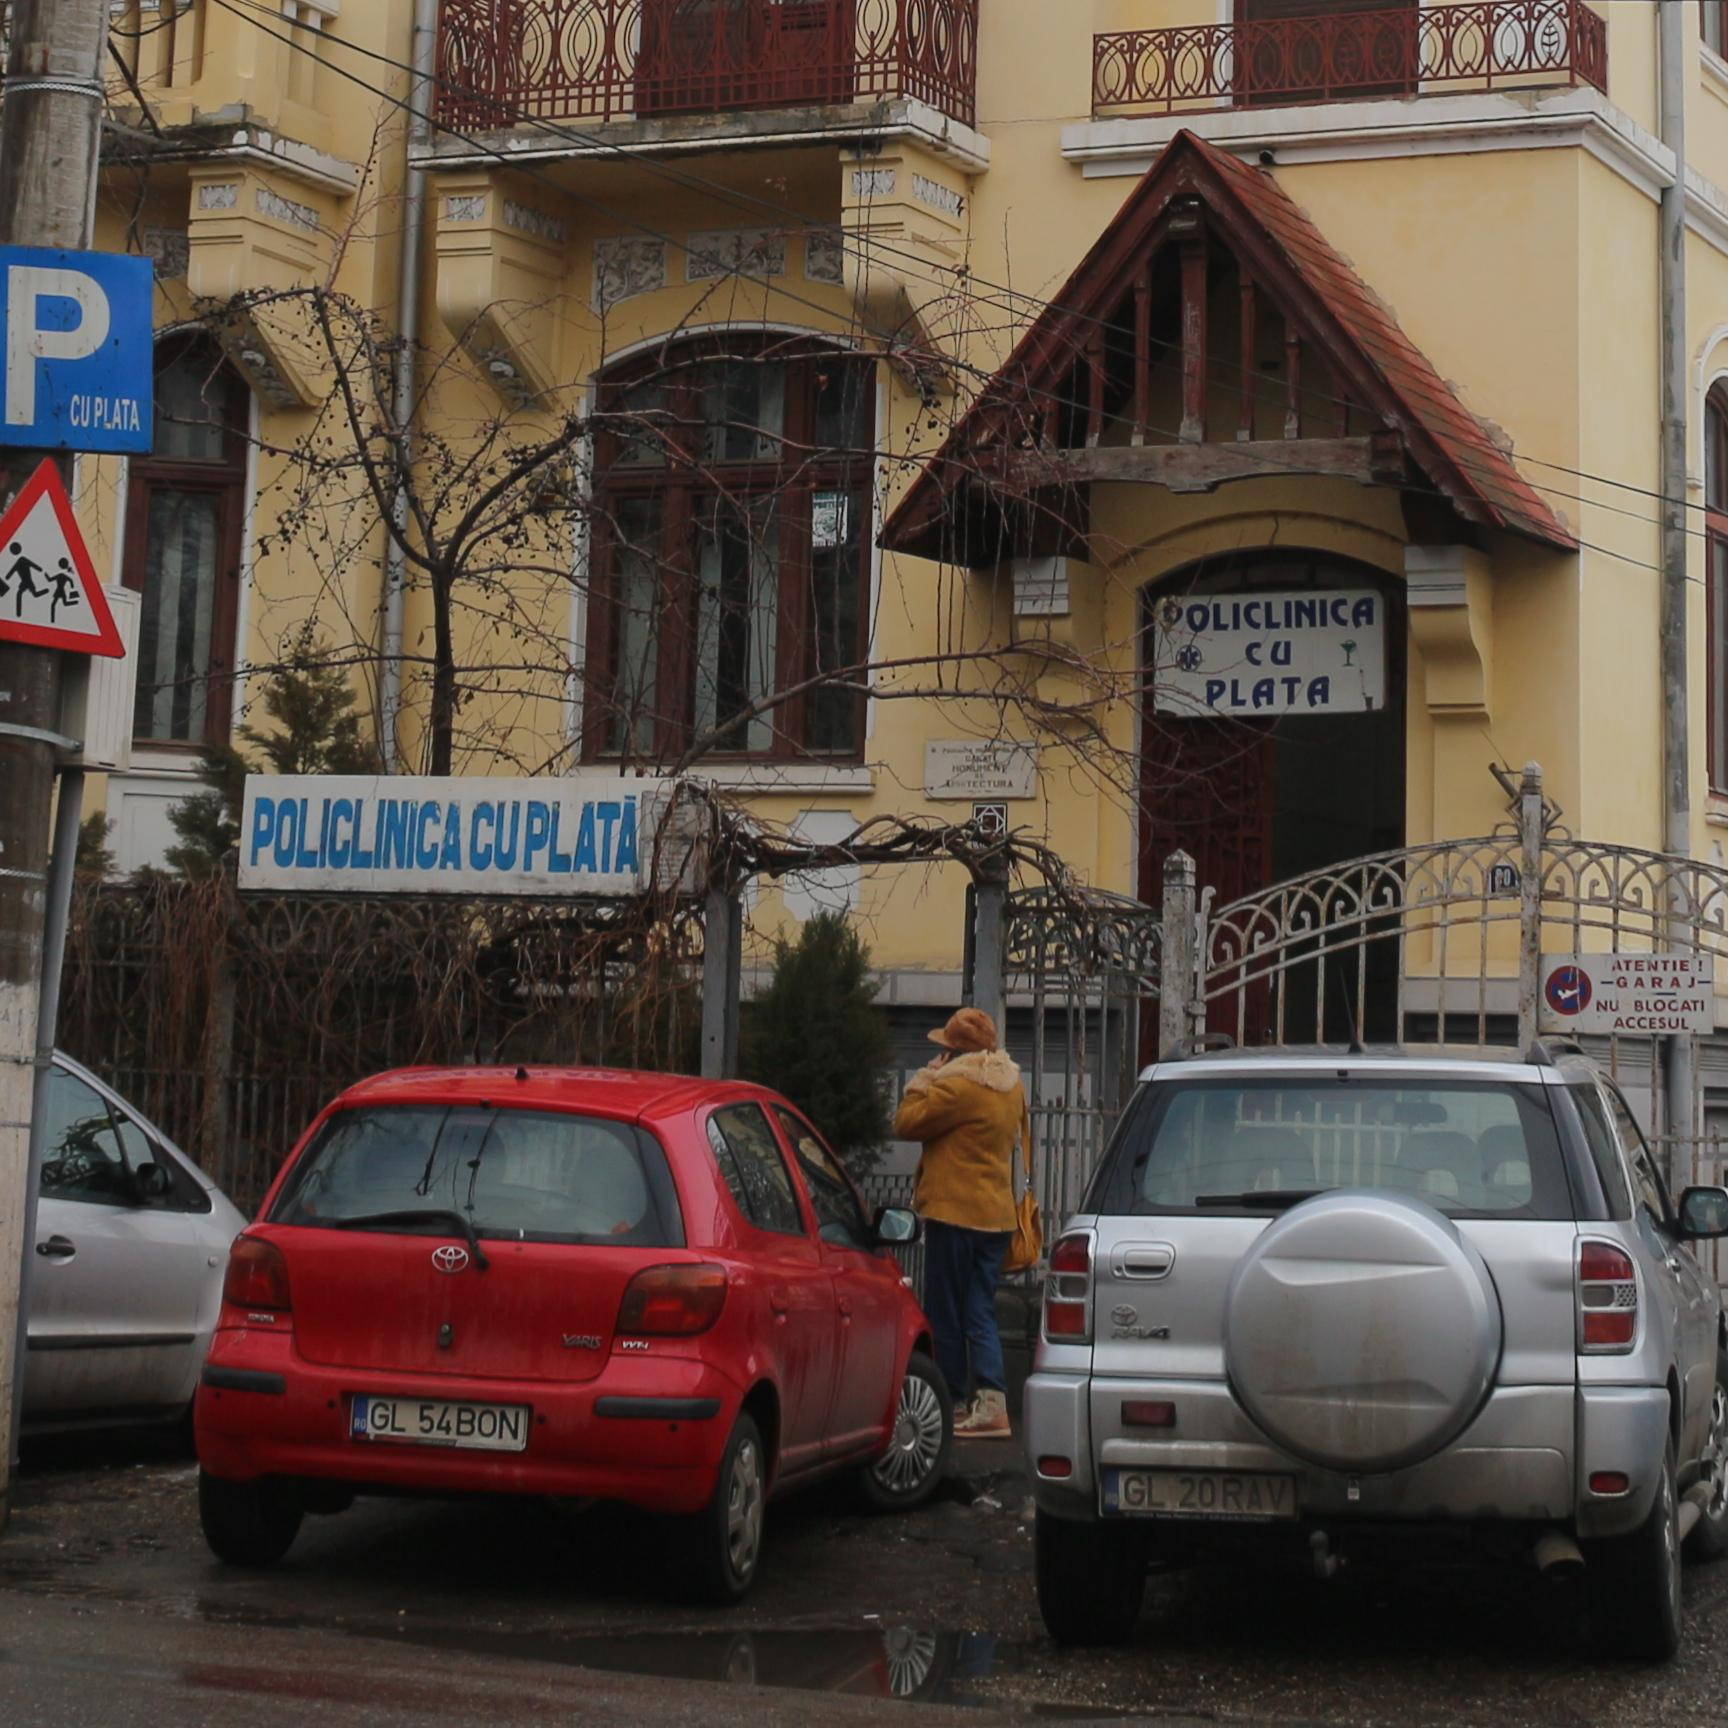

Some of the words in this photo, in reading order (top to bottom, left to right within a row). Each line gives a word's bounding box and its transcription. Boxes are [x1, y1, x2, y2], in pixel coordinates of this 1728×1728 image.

[5, 265, 111, 426] P
[70, 394, 91, 428] CU
[94, 396, 141, 432] PLATA
[1162, 597, 1375, 633] POLICLINICA
[1245, 640, 1292, 667] CU
[1205, 675, 1330, 709] PLATA
[250, 796, 462, 871] POLICLINICA
[469, 800, 519, 872] CU
[523, 794, 639, 874] PLATĂ
[1611, 959, 1690, 972] ATENTIE
[1615, 976, 1697, 989] GARAJ
[1595, 1000, 1619, 1012] NU
[1634, 999, 1705, 1013] BLOCATI
[1613, 1016, 1690, 1030] ACCESUL
[370, 1401, 406, 1433] GL
[1123, 1475, 1166, 1508] GL
